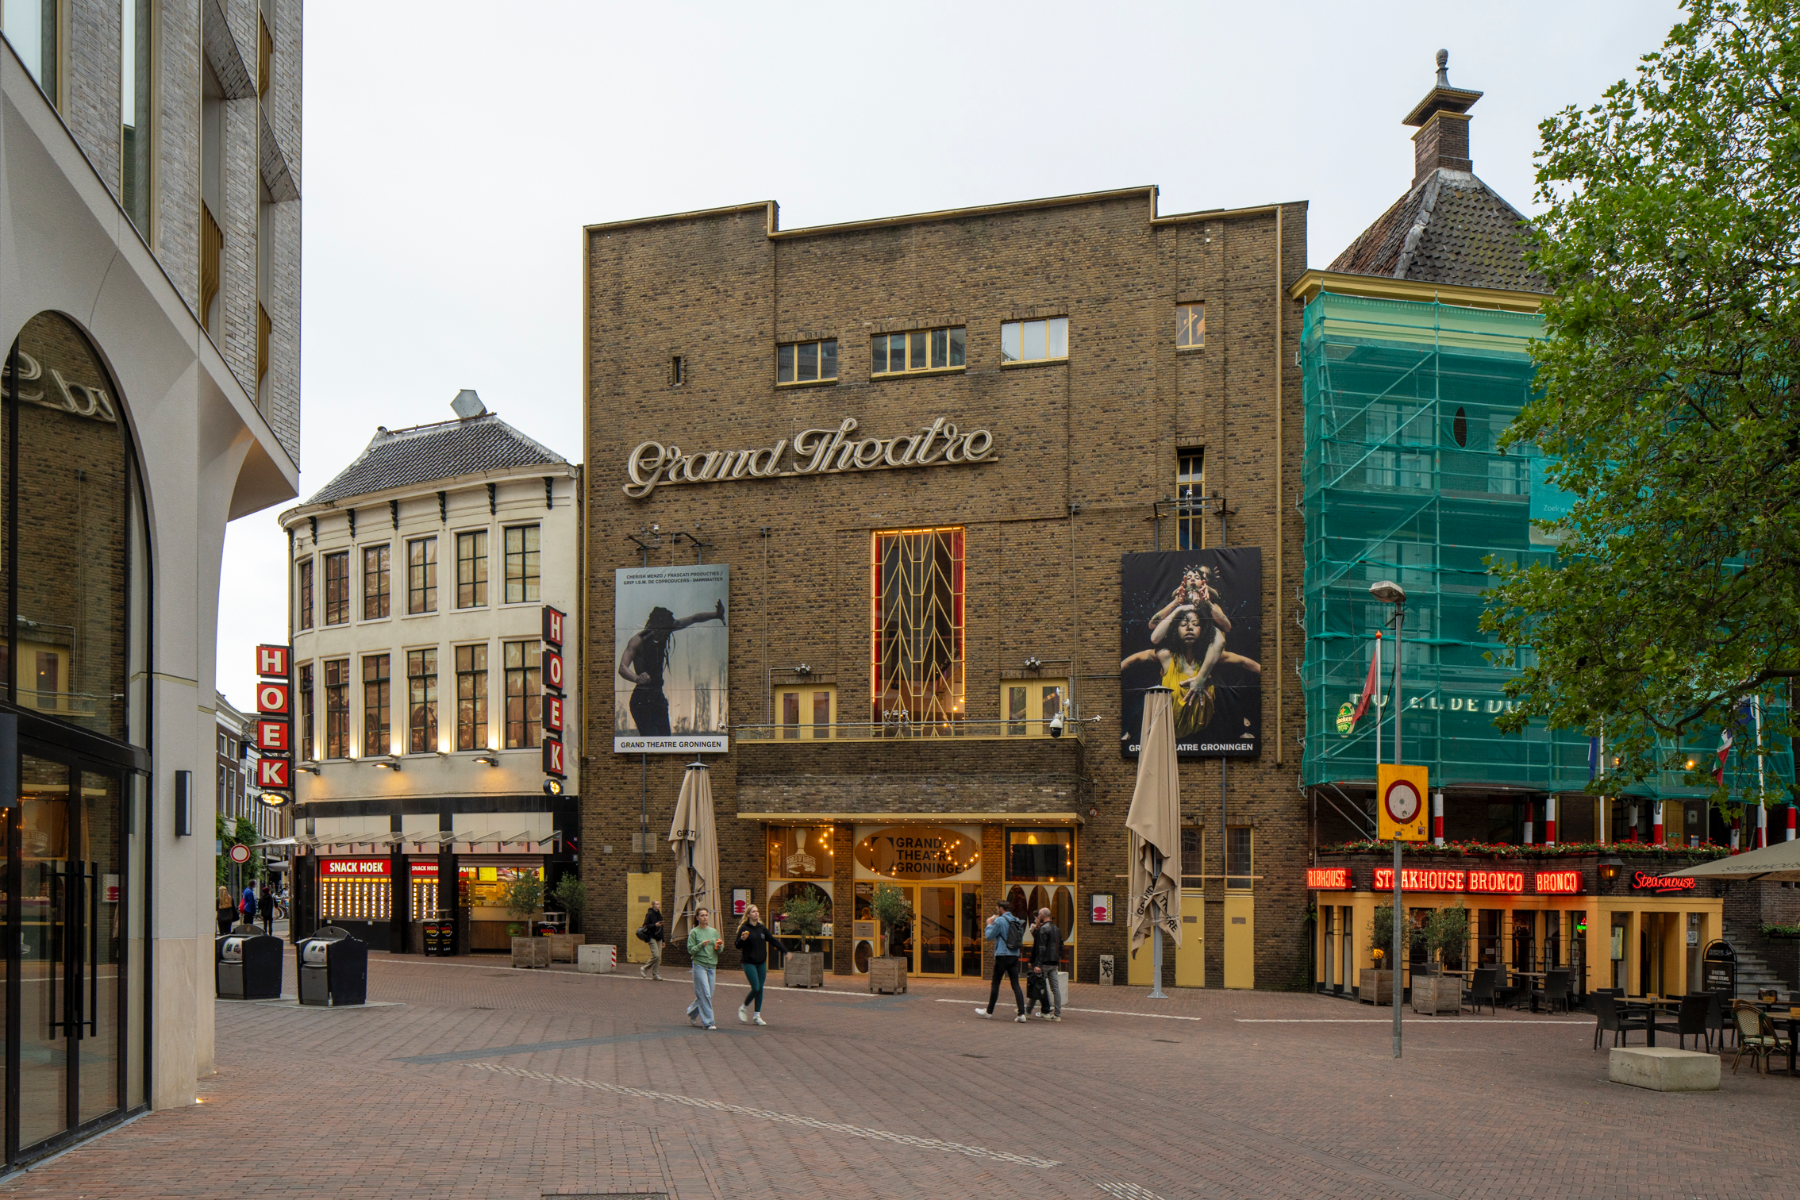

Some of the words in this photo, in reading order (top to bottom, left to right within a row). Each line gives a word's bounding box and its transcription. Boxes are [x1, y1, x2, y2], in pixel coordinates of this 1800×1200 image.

[622, 439, 788, 499] Grand
[793, 417, 997, 476] Theatre
[550, 611, 562, 771] HOEK
[260, 650, 284, 785] HOEK
[620, 741, 646, 749] GRAND
[1175, 743, 1199, 751] EATRE
[1200, 743, 1254, 751] GRONINGEN
[896, 837, 942, 848] GRAND
[896, 849, 956, 862] THEATRE
[329, 862, 358, 873] SNACK
[360, 862, 384, 873] HOEK
[1308, 870, 1346, 888] RIBHOUSE
[1376, 870, 1464, 890] STAKHOUSE
[1470, 872, 1523, 891] BRONCO
[1536, 873, 1576, 891] BRONCO
[1632, 870, 1696, 890] Steakhouse
